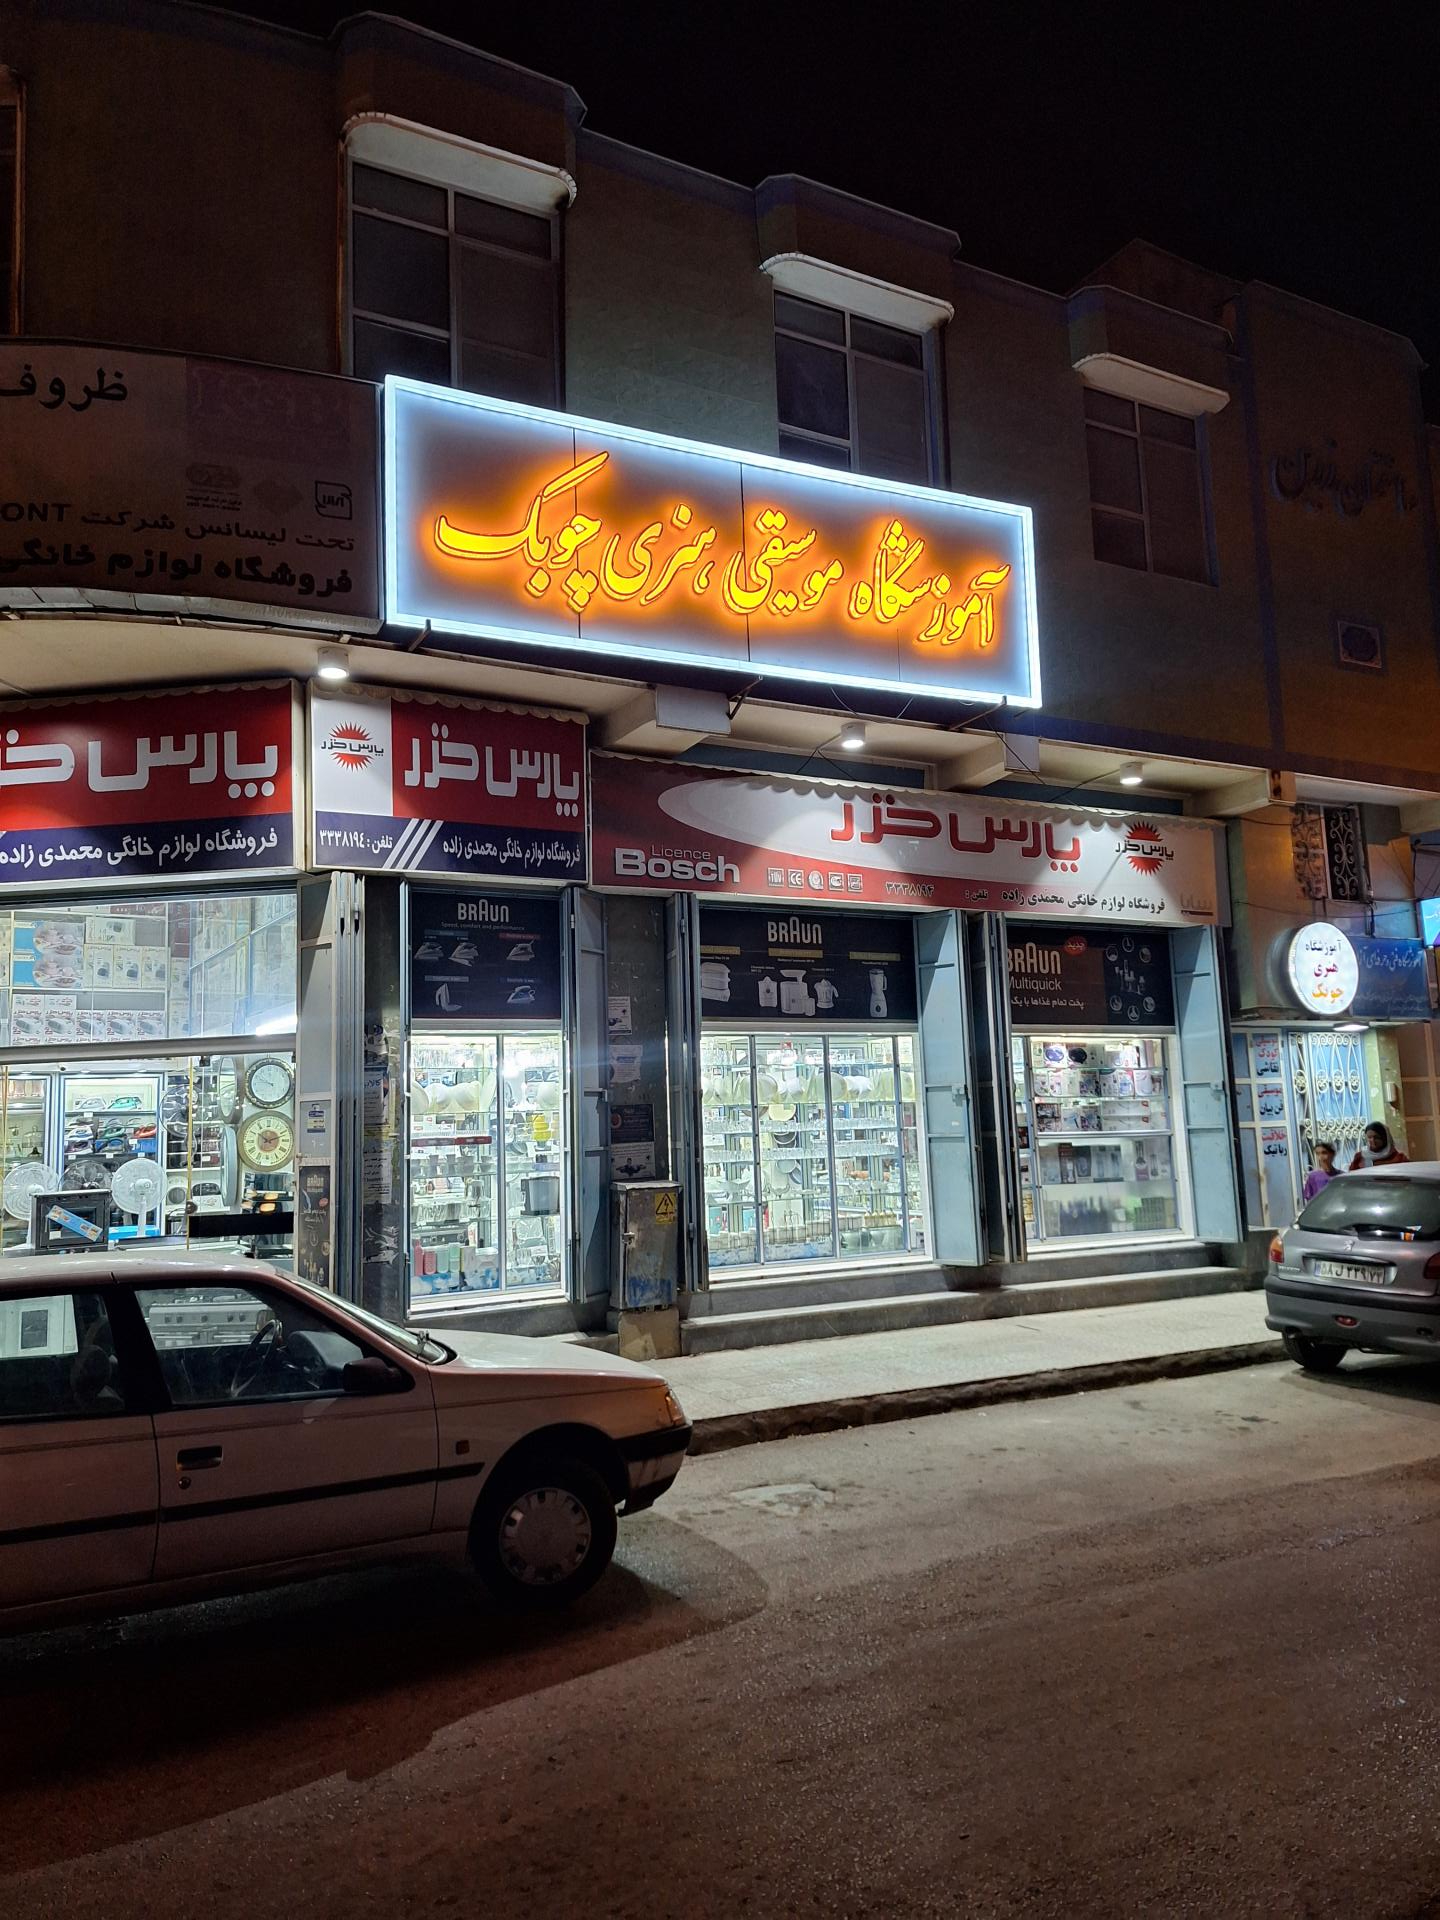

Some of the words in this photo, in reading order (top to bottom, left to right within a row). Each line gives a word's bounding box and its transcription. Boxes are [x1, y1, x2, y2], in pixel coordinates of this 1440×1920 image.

[0, 364, 127, 411] ظروف
[82, 511, 175, 532] شرکت
[185, 522, 286, 546] لیسانس
[296, 535, 354, 551] تحت
[107, 549, 202, 580] لوازم
[722, 508, 844, 616] موسیقی
[215, 556, 353, 597] فروشگاه
[848, 520, 1011, 648] آموزشگاه
[321, 738, 348, 751] خزر
[348, 741, 384, 757] پارس
[404, 722, 480, 789] خزر
[87, 730, 279, 799] پارس
[485, 746, 580, 817] پارس
[830, 792, 943, 845] خزر
[38, 843, 103, 868] محمدی
[107, 835, 154, 866] خانگی
[158, 833, 200, 866] لوازم
[204, 827, 279, 857] فروشگاه
[443, 835, 463, 858] زاده
[464, 840, 498, 860] محمدی
[499, 837, 523, 864] خانگی
[524, 841, 545, 869] لوازم
[546, 841, 580, 868] فروشگاه
[651, 844, 711, 861] Licence
[948, 811, 1082, 874] پارس
[1114, 837, 1140, 854] خزر
[1139, 841, 1174, 861] پارس
[615, 847, 741, 884] Bosch
[1002, 888, 1025, 905] زاده
[1067, 894, 1098, 909] خانگی
[1101, 895, 1126, 911] لوازم
[1128, 897, 1166, 914] فروشگاه
[457, 899, 510, 923] BRAUN
[767, 916, 823, 945] BRAUN
